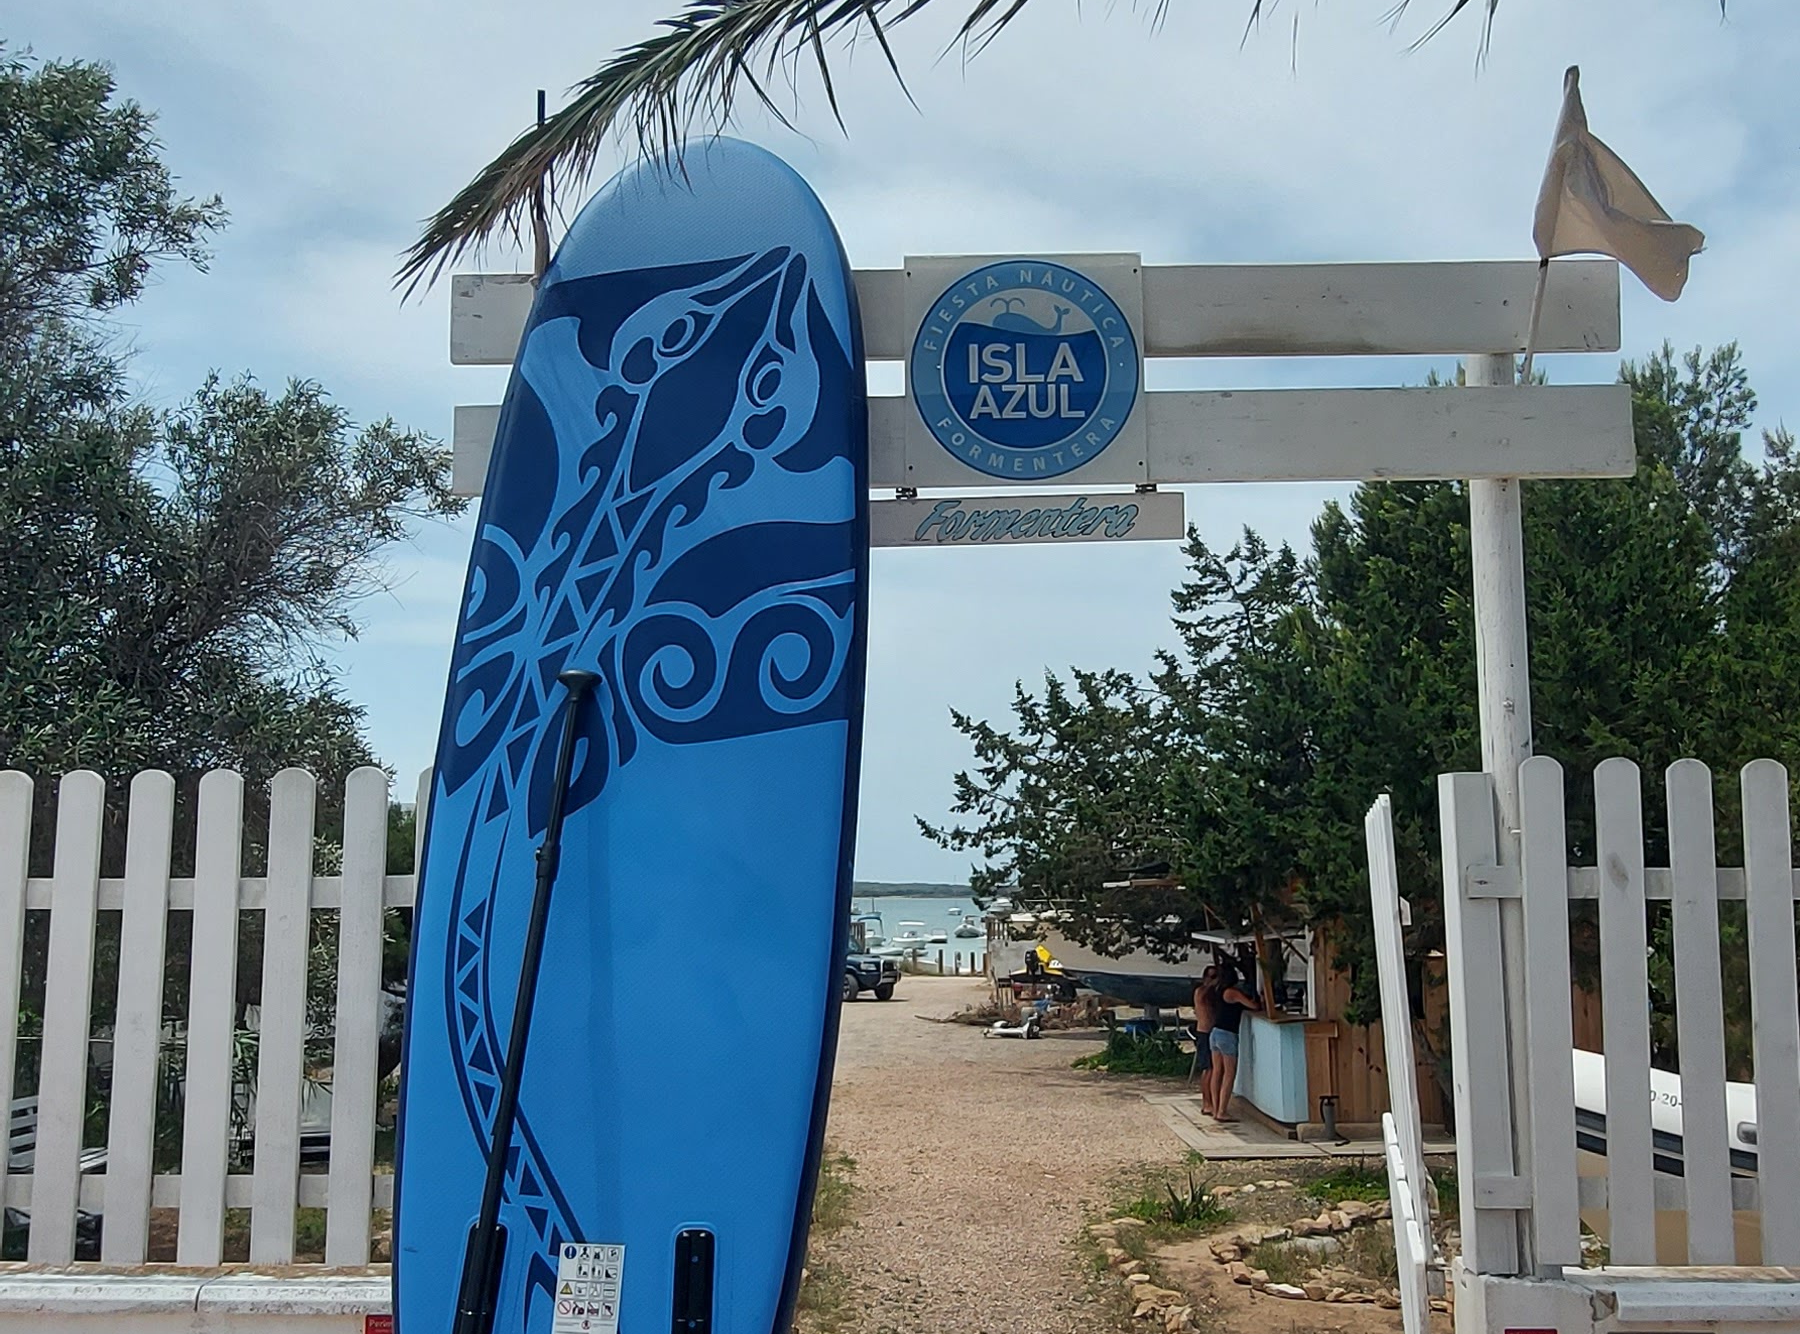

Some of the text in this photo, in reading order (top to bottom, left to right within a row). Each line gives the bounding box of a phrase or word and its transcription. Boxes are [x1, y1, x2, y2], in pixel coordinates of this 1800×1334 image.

[924, 275, 999, 352] FIESTA
[968, 342, 1084, 384] ISLA
[969, 384, 1086, 420] AZUL
[936, 416, 1116, 472] FORMENTERA
[915, 497, 1140, 542] Formentera
[369, 1319, 393, 1328] Perím
